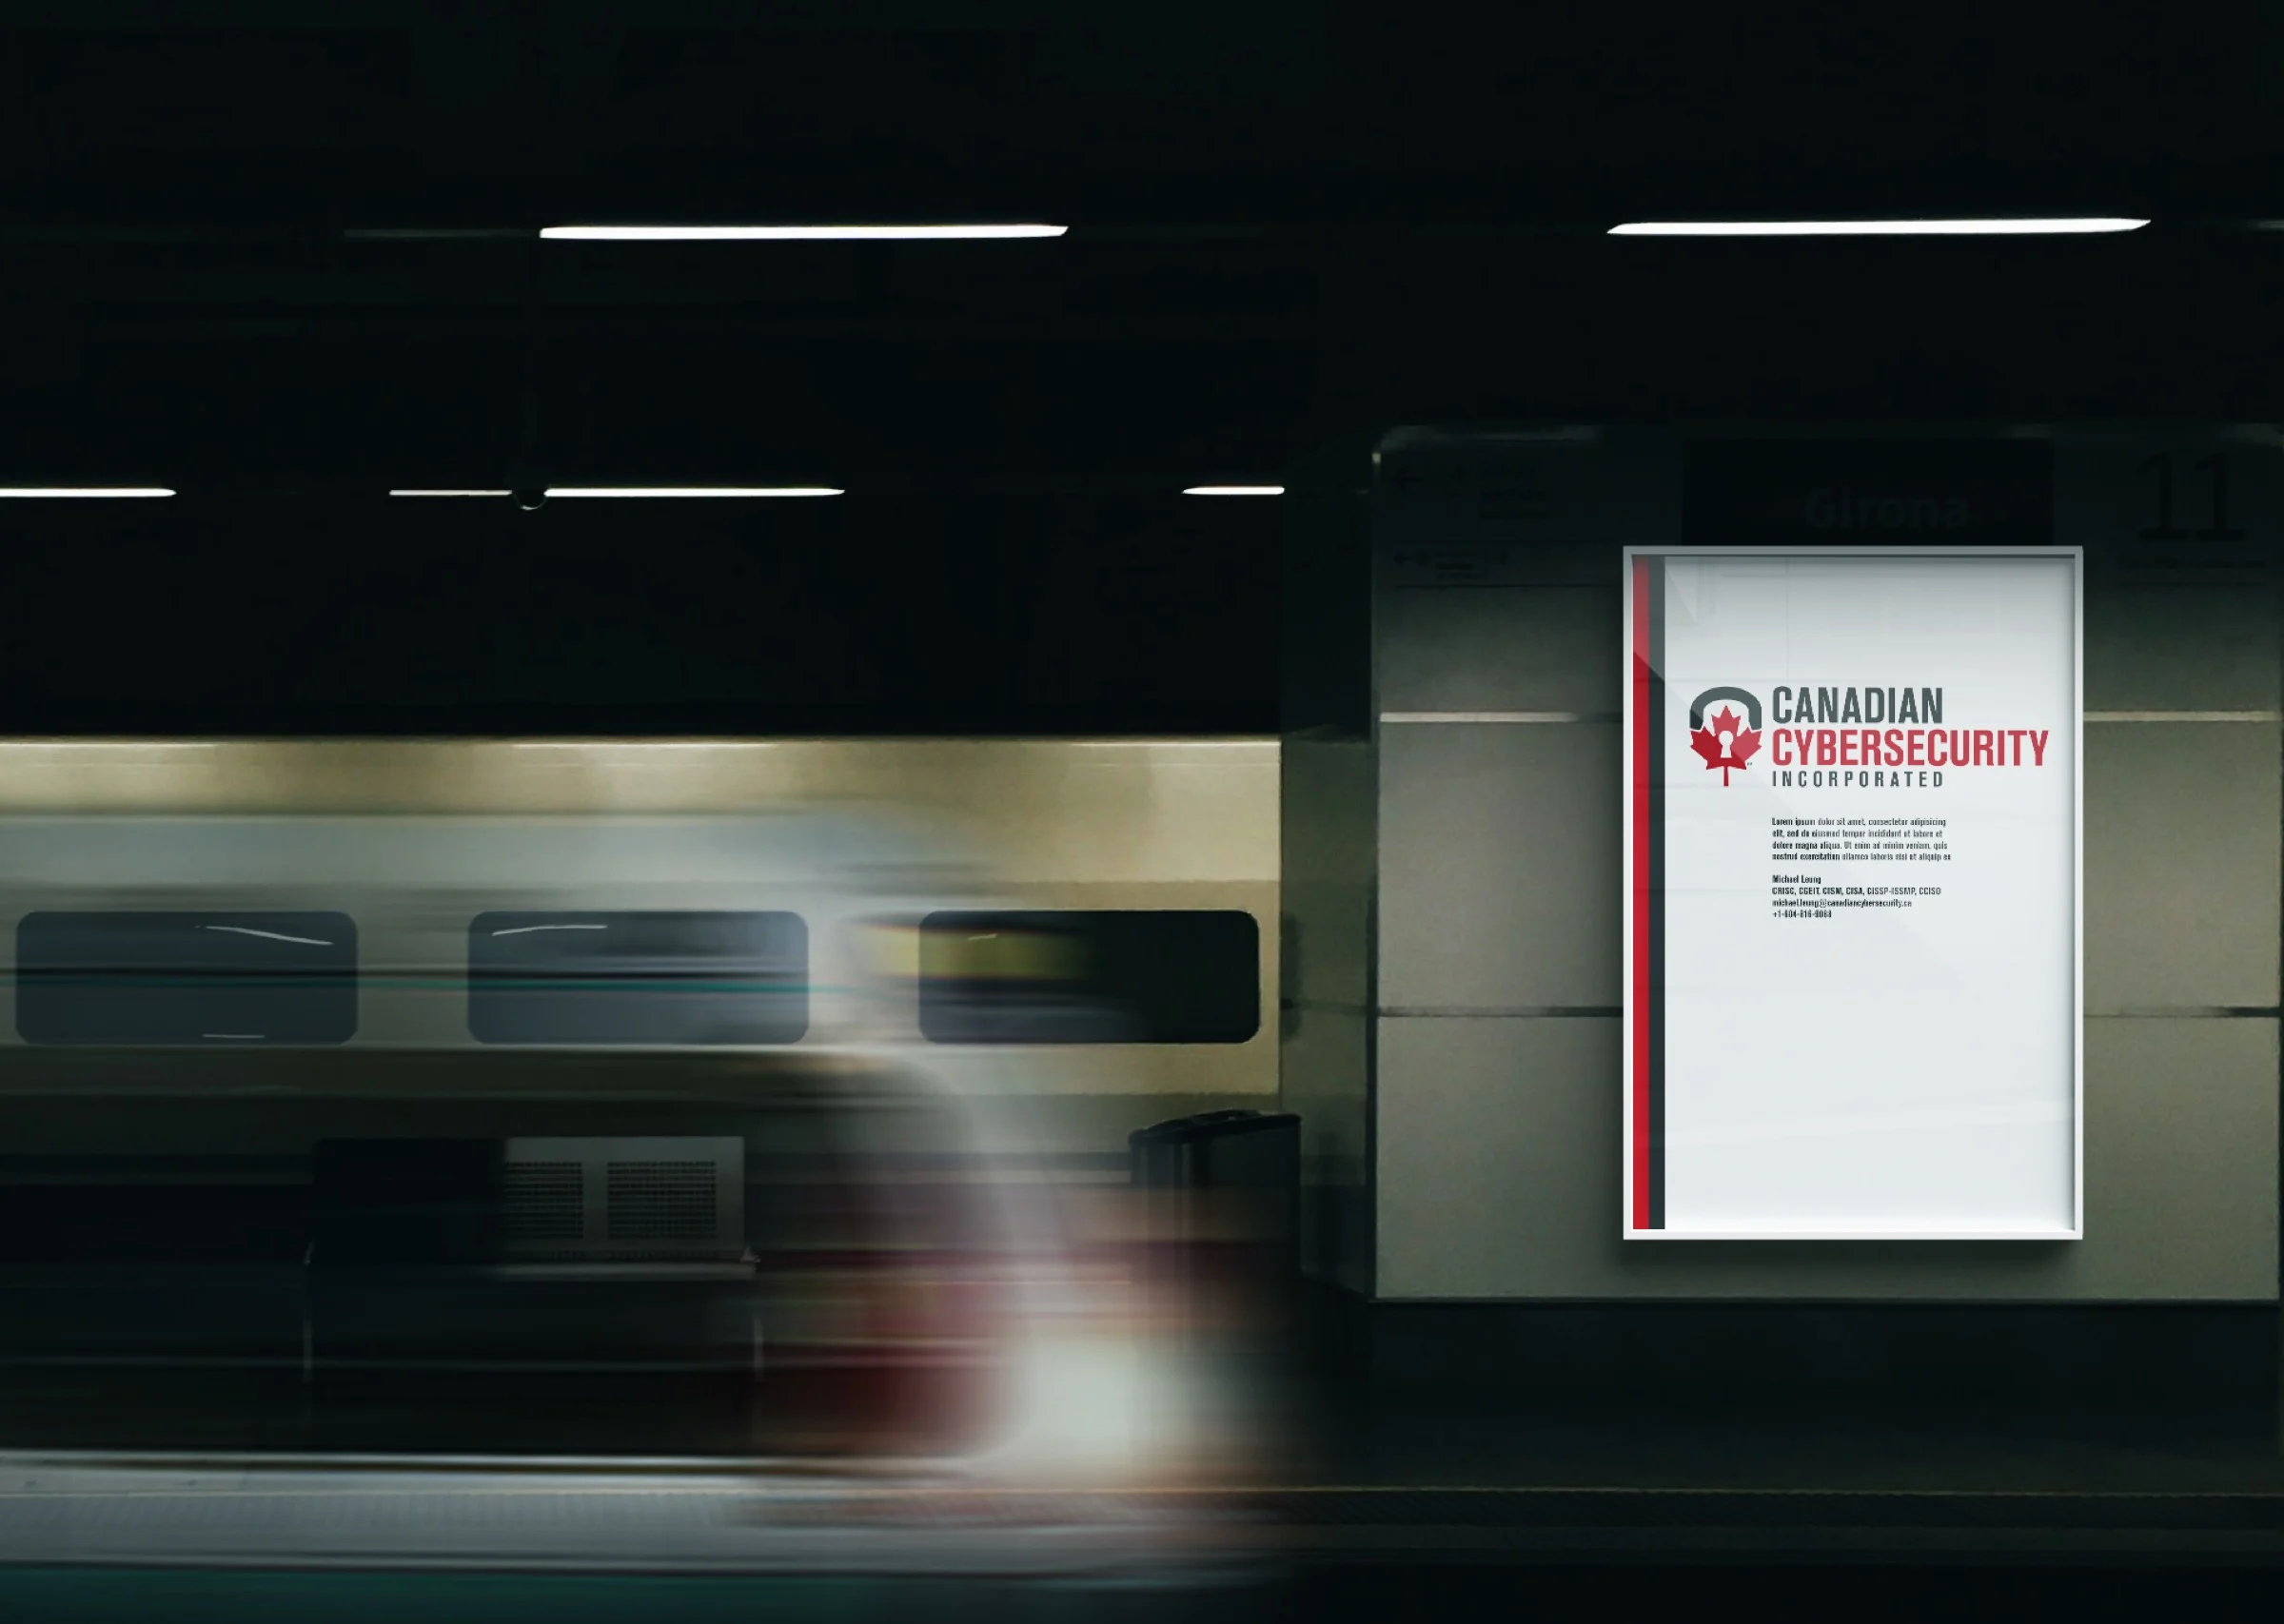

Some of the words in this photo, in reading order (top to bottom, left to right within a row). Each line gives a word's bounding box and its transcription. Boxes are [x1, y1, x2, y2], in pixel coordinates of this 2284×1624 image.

[1772, 686, 1942, 724] CANADIAN
[1772, 728, 2049, 767] CYBERSECURITY
[1772, 771, 1942, 788] INCORPORATED
[1772, 817, 1793, 826] Lorem
[1795, 817, 1815, 826] ipsum
[1772, 830, 1784, 838] elit,
[1842, 830, 1865, 838] tempor
[1934, 841, 1947, 851] quis
[1919, 853, 1941, 862] aliquip
[1772, 874, 1799, 883] Michael
[1802, 875, 1821, 884] Leung
[1772, 888, 1796, 896] CRISC,
[1822, 888, 1844, 896] CISM,
[1846, 888, 1864, 896] CISA,
